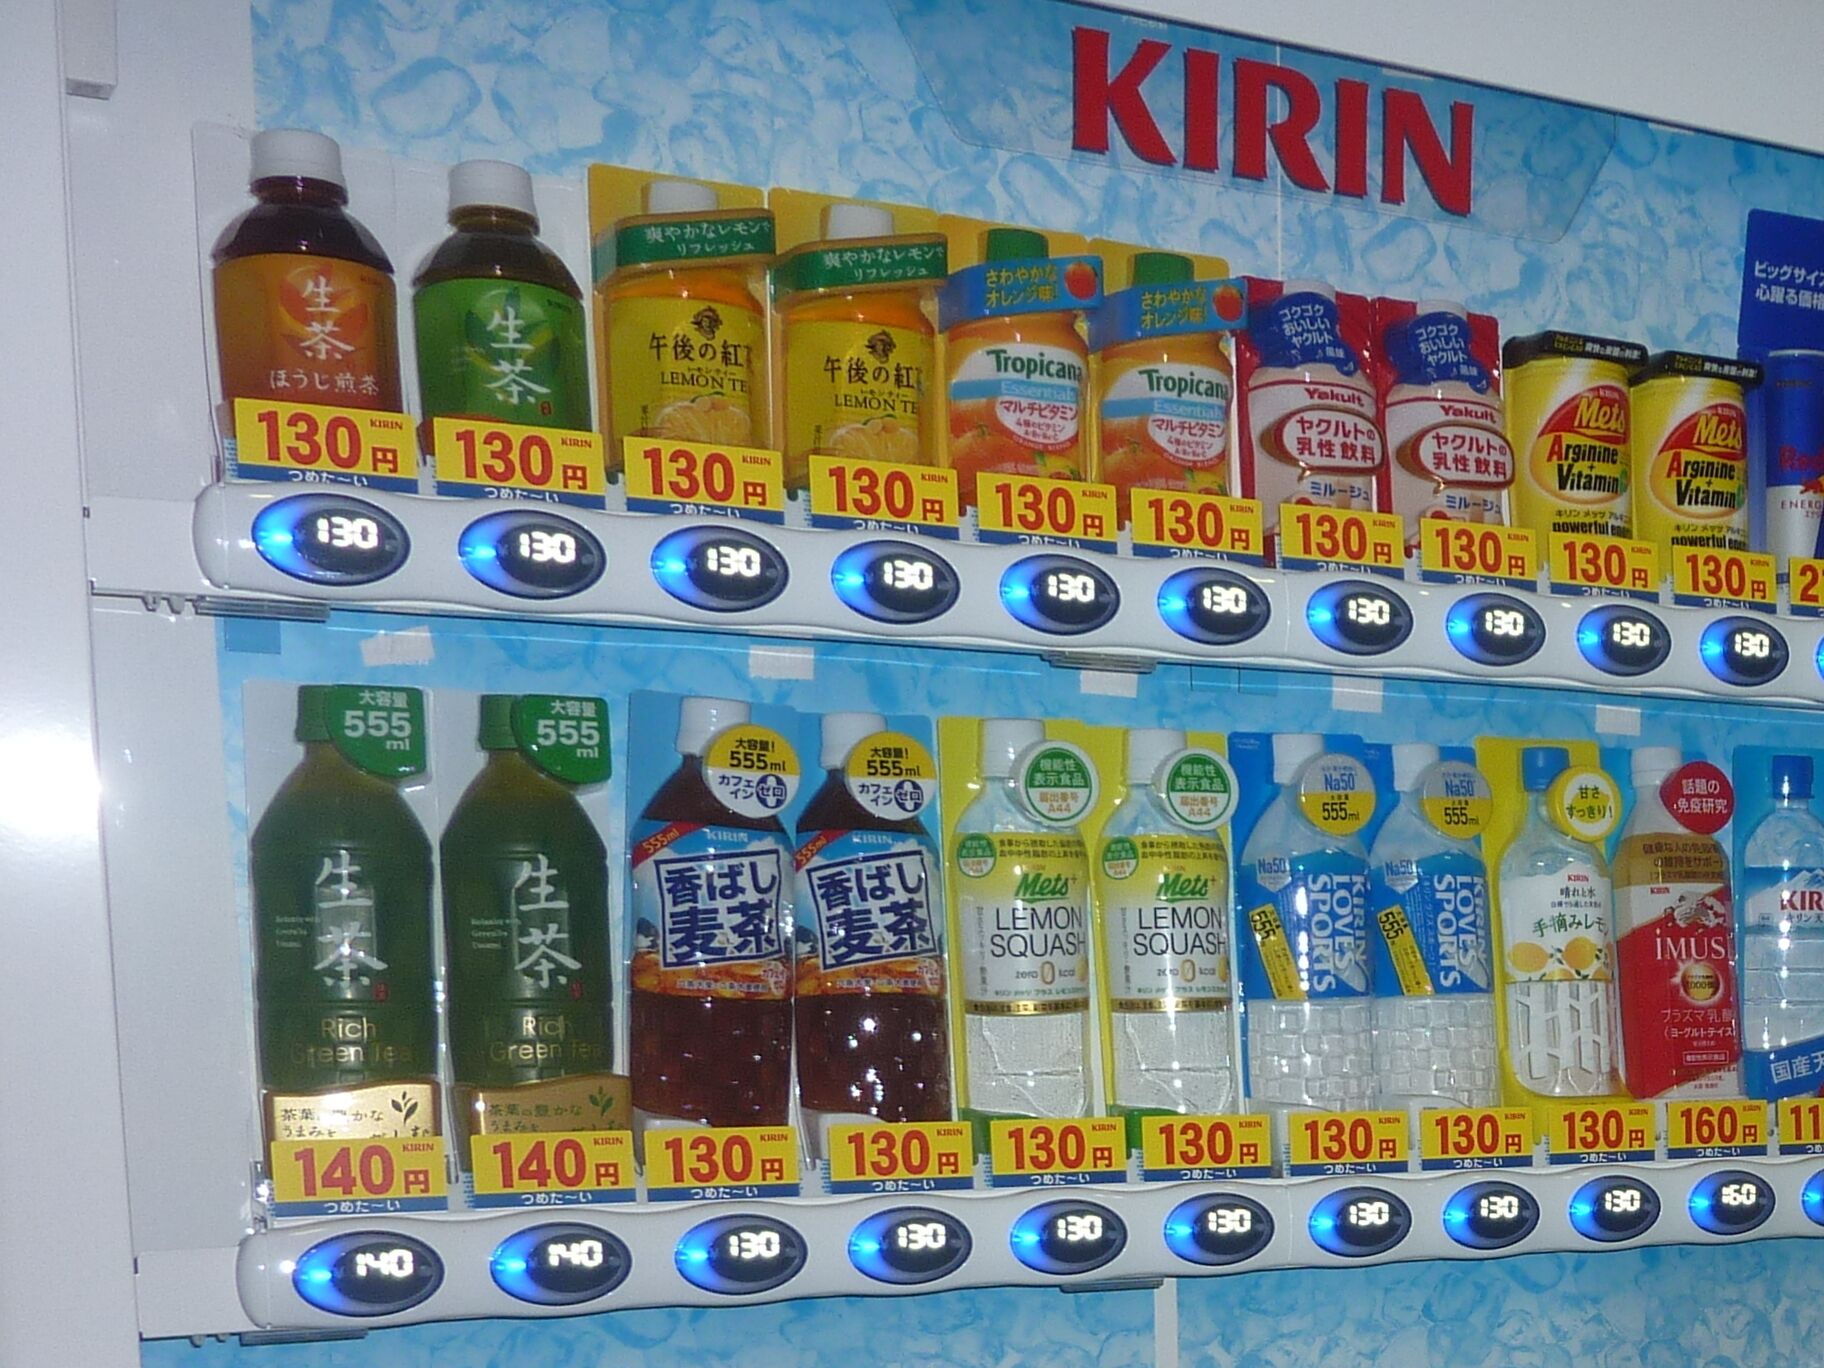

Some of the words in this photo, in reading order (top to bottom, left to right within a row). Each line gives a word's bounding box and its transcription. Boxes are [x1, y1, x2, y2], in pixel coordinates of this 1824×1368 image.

[1071, 26, 1475, 218] KIRIN
[676, 242, 755, 256] リフレッシュ
[299, 275, 356, 361] 生茶
[1292, 330, 1334, 348] ヤクルト
[986, 348, 1083, 382] Tropicana
[269, 368, 380, 397] ほうじ煎茶
[660, 371, 724, 390] LEMON
[1304, 387, 1366, 408] Yakult
[1000, 400, 1078, 422] マルチビタミン
[1574, 396, 1626, 432] Mets
[369, 419, 404, 431] KIRIN
[1296, 416, 1377, 442] ヤクルトの
[560, 436, 593, 449] KIRIN
[1296, 436, 1376, 465] 乳性飲料
[1546, 433, 1619, 464] Arginine
[742, 455, 771, 467] KIRIN
[317, 516, 378, 550] 130
[883, 560, 933, 590] 130
[1203, 586, 1247, 614] 130
[1734, 632, 1770, 658] 130
[359, 691, 409, 709] 大容量
[343, 711, 412, 738] 555
[385, 736, 411, 751] ml
[735, 737, 775, 751] 大容量!
[729, 750, 787, 772] 555ml
[718, 774, 754, 787] カフェ
[756, 784, 786, 799] ゼロ
[1032, 771, 1086, 788] 表示食品
[1681, 778, 1720, 796] 話題の
[729, 786, 754, 800] イン
[1578, 785, 1601, 800] 甘さ
[1566, 803, 1615, 820] すっきり!
[1676, 797, 1728, 816] 免疫研究
[665, 861, 778, 906] 香ばし
[668, 901, 776, 962] 麦茶
[1308, 874, 1336, 992] SPORTS
[1331, 874, 1353, 971] LOVES
[990, 932, 1086, 958] SQUASH
[321, 1015, 377, 1039] Rich
[1721, 1183, 1756, 1206] 160
[1057, 1215, 1103, 1241] 130
[355, 1249, 414, 1278] 140
[548, 1240, 603, 1268] 140
